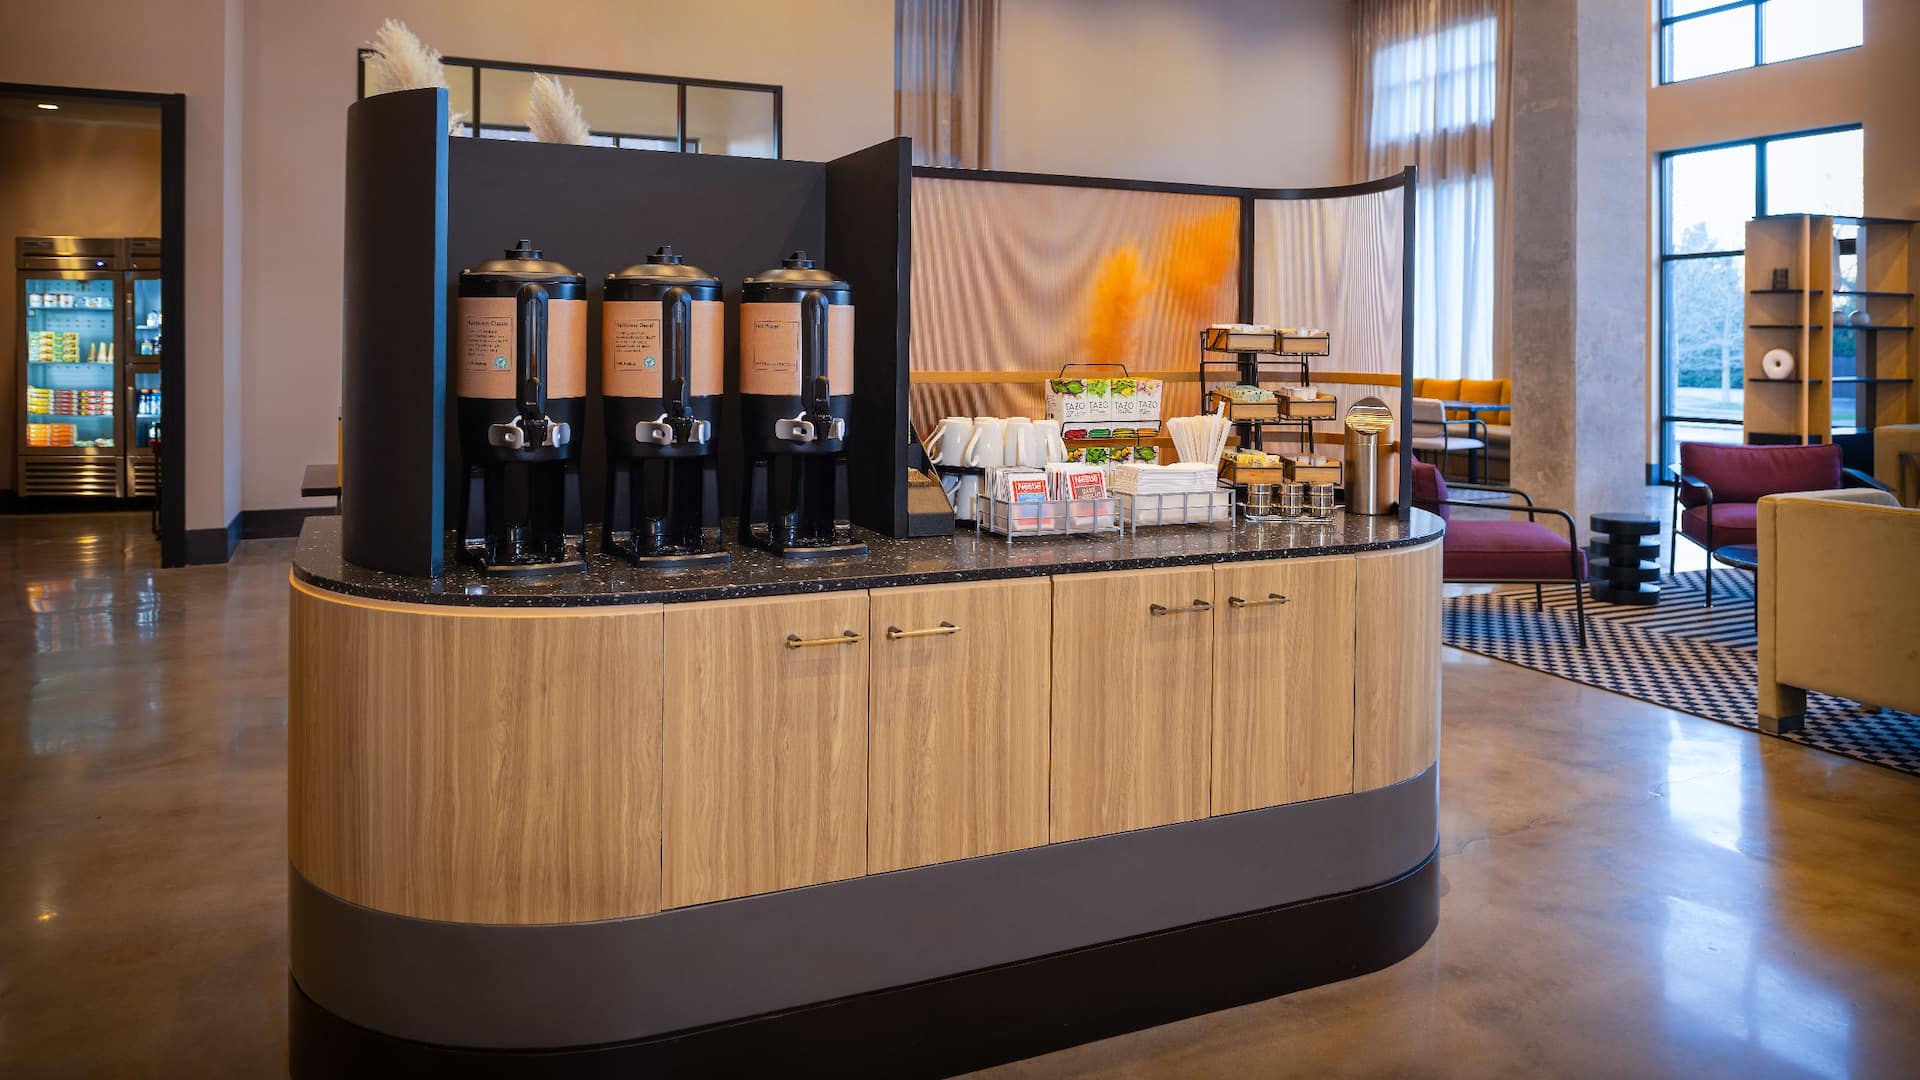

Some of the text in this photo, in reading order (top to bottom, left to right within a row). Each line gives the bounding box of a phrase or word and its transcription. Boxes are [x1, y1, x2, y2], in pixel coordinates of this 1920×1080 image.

[1065, 402, 1085, 411] TAZO
[1089, 401, 1108, 409] TAZO
[1115, 401, 1134, 410] TAZO
[1138, 400, 1158, 409] TAZO
